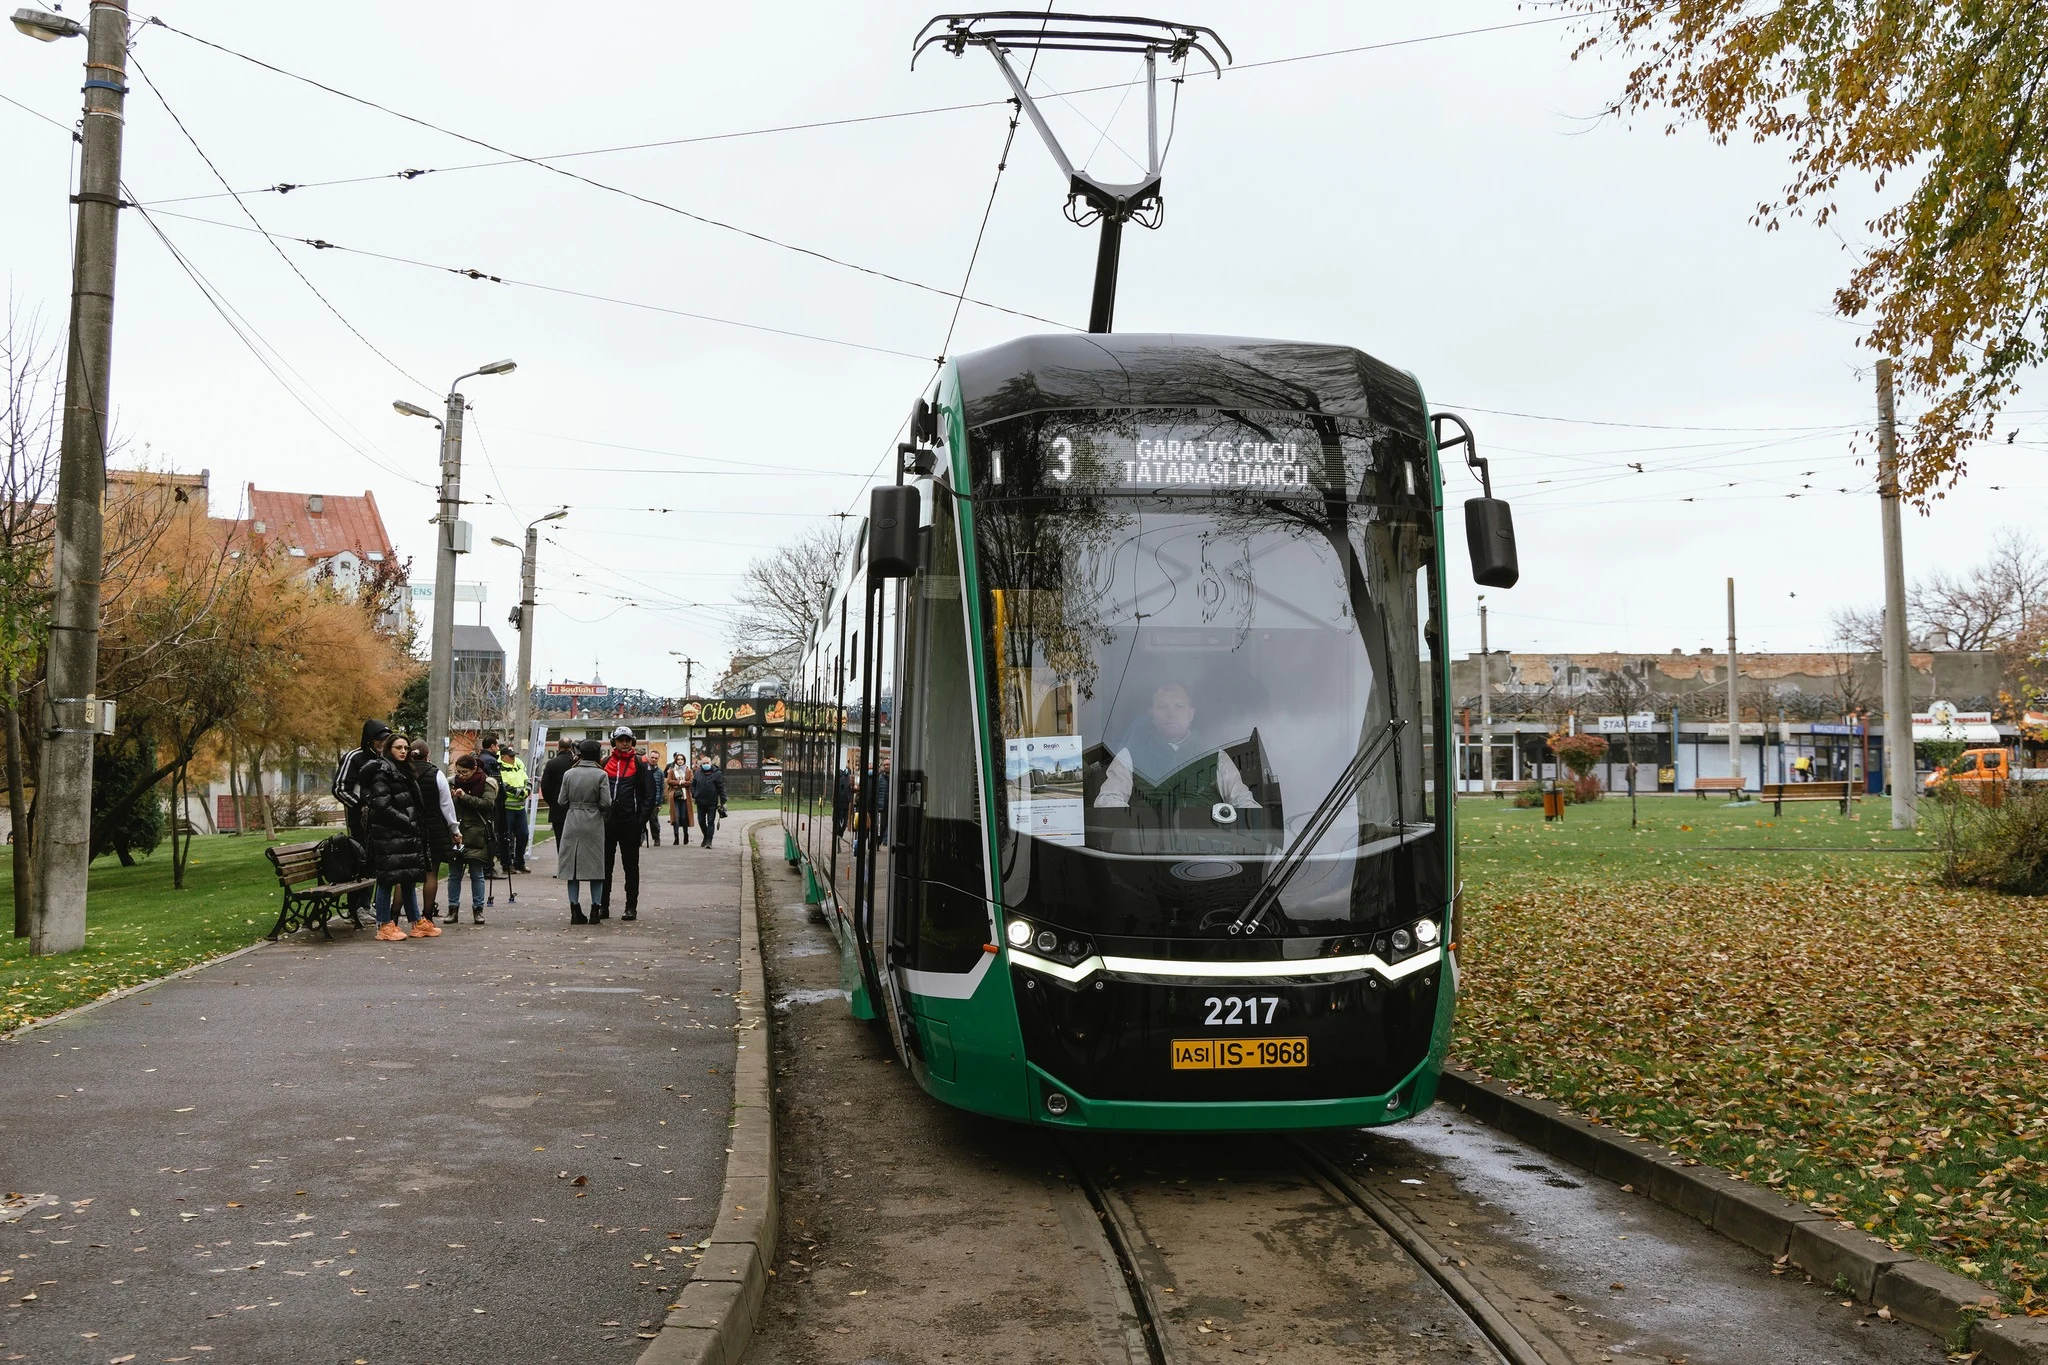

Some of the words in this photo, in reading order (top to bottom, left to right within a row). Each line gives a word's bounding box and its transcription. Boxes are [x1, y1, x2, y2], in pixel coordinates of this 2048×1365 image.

[1052, 437, 1073, 480] 3
[1136, 439, 1297, 463] GARA-TG.CUCU
[1124, 461, 1308, 486] TATARASI-DANCU
[411, 588, 432, 596] ENS
[701, 700, 733, 722] Cibo
[1204, 997, 1279, 1025] 2217
[1176, 1047, 1209, 1062] IASI
[1220, 1043, 1305, 1065] IS-1968
